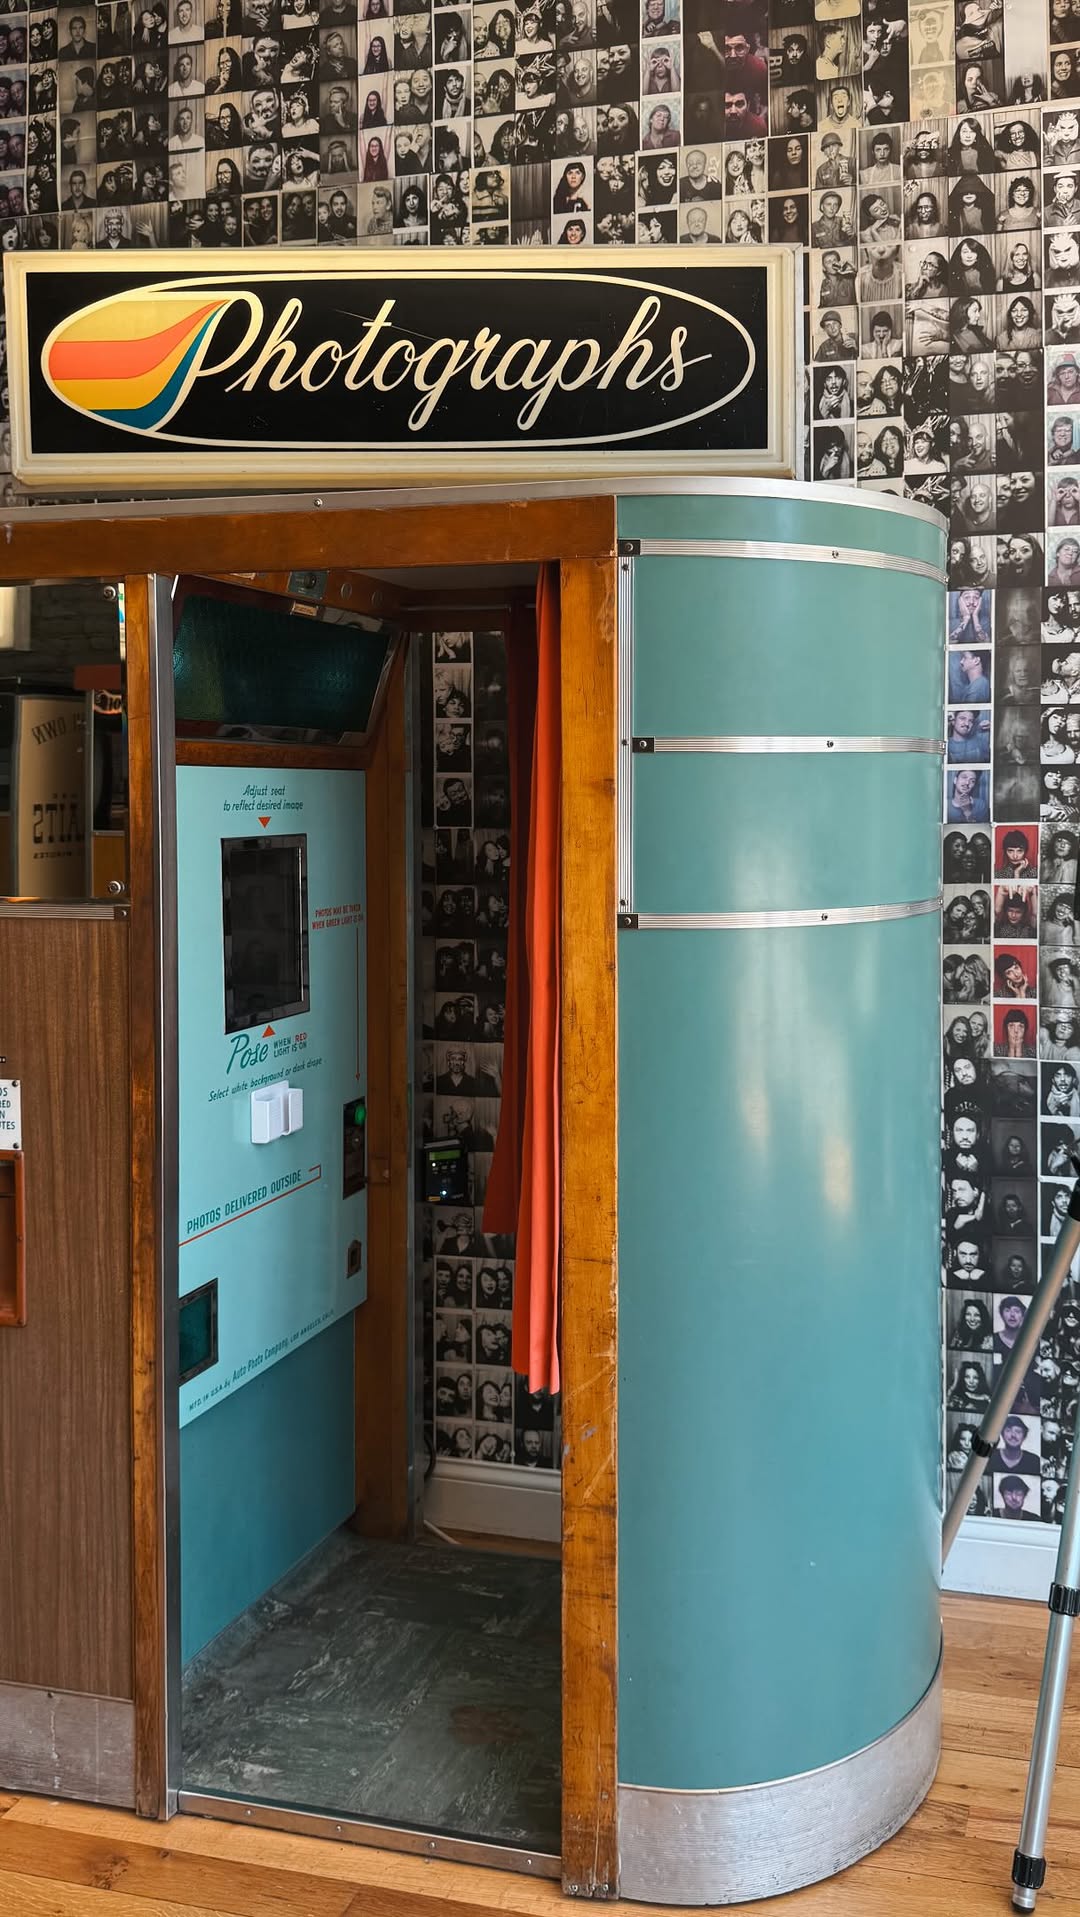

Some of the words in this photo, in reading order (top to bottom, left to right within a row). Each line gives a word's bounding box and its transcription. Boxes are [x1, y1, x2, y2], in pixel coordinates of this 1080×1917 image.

[160, 290, 712, 431] Photographs
[243, 784, 268, 799] Adjust
[270, 785, 286, 796] seat
[223, 800, 231, 811] to
[231, 799, 256, 811] reflect
[256, 799, 283, 811] desired
[283, 800, 304, 811] image
[274, 1037, 292, 1050] WHEN
[295, 1032, 308, 1043] RED
[274, 1046, 290, 1058] LIGHT
[292, 1043, 298, 1053] IS
[299, 1041, 307, 1050] ON
[226, 1033, 269, 1074] Pose
[208, 1086, 229, 1102] Select
[231, 1081, 248, 1095] white
[250, 1067, 285, 1087] background
[285, 1068, 292, 1077] or
[186, 1207, 221, 1234] PHOTOS
[225, 1185, 268, 1216] DELIVERED
[270, 1169, 302, 1195] OUTSIDE
[232, 1365, 247, 1382] Auto
